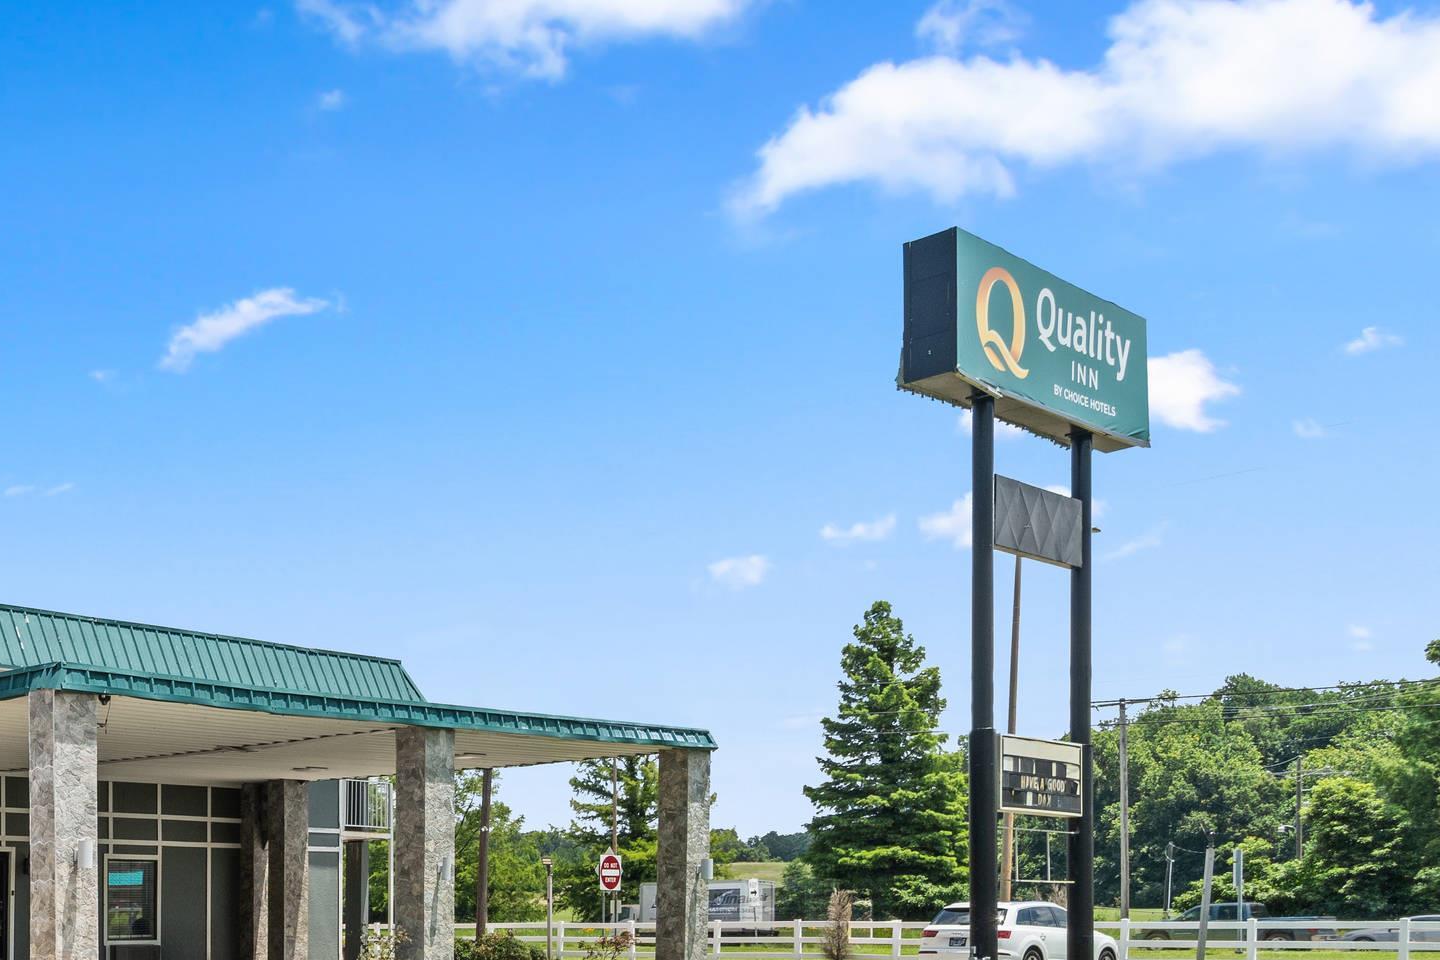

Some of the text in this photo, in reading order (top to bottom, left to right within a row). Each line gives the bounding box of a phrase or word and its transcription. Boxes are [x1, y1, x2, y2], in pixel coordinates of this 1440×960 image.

[1036, 287, 1131, 382] Quality
[1071, 360, 1099, 391] INN
[1053, 384, 1116, 417] BY CHOICE HOTELS
[1047, 778, 1065, 793] GOOD
